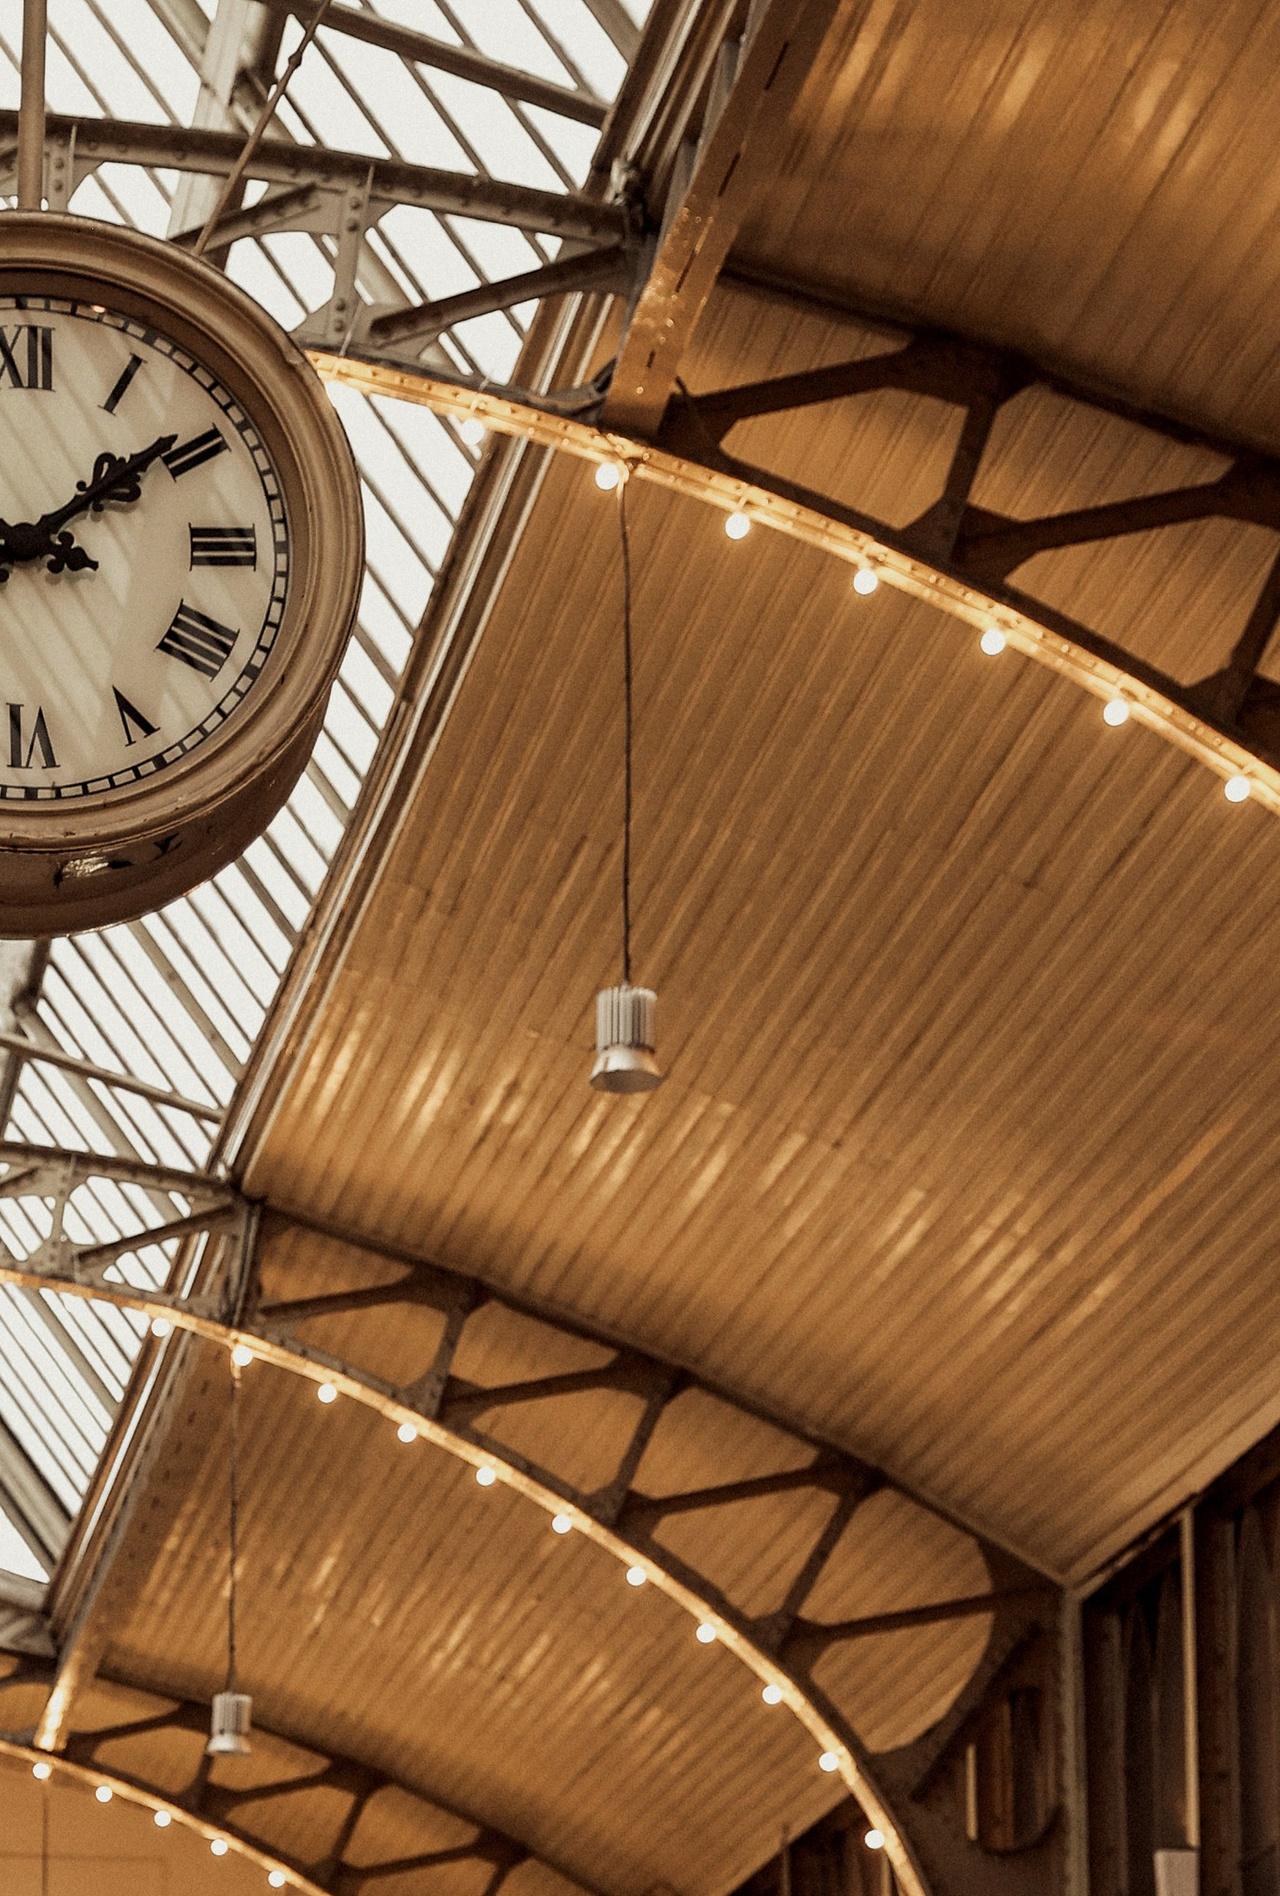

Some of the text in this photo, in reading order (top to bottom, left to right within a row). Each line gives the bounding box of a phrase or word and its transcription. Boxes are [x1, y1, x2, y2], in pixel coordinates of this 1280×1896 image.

[97, 352, 148, 415] I
[159, 422, 232, 483] II
[188, 522, 257, 572] III
[153, 598, 240, 682] IIII
[5, 702, 61, 770] VI
[112, 684, 161, 747] V
